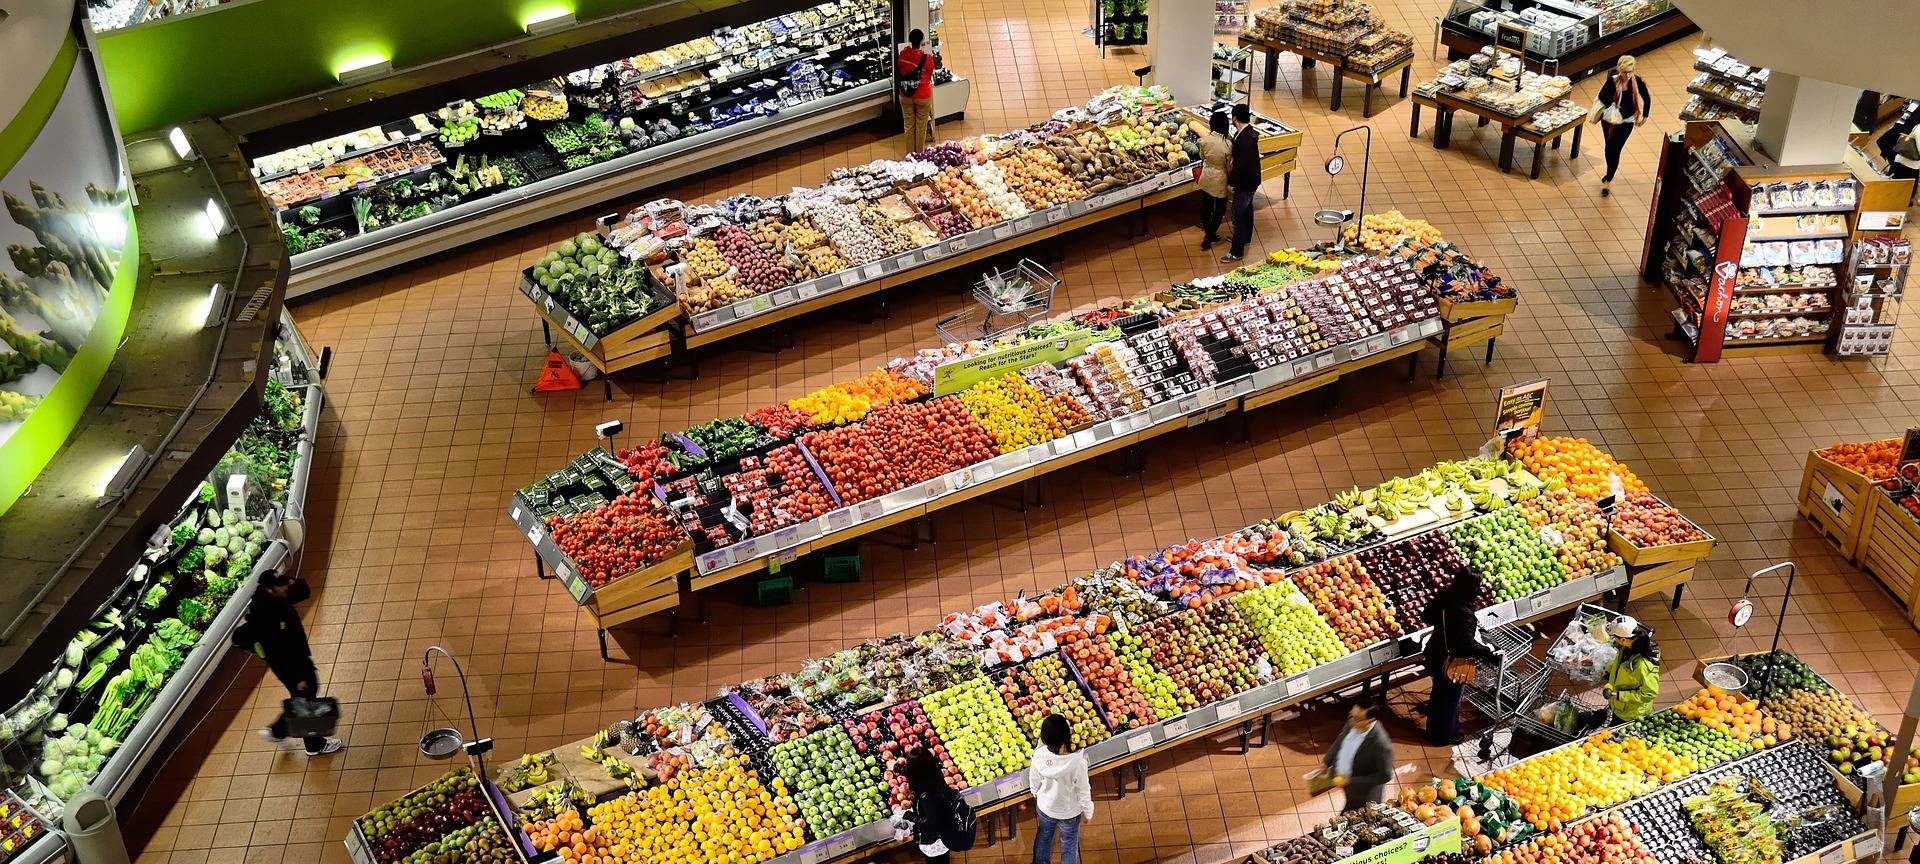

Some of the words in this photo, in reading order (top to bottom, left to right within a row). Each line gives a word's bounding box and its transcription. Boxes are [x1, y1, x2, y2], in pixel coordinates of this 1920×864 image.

[1714, 261, 1737, 322] Vachon
[964, 359, 986, 369] Looking
[998, 350, 1027, 361] nutritious
[1028, 342, 1052, 353] choices?
[979, 362, 996, 370] Reach
[1008, 356, 1018, 364] the
[1020, 352, 1037, 361] Stars!
[1503, 405, 1517, 415] Simple
[1504, 398, 1515, 407] Easy
[1374, 842, 1407, 860] choices?
